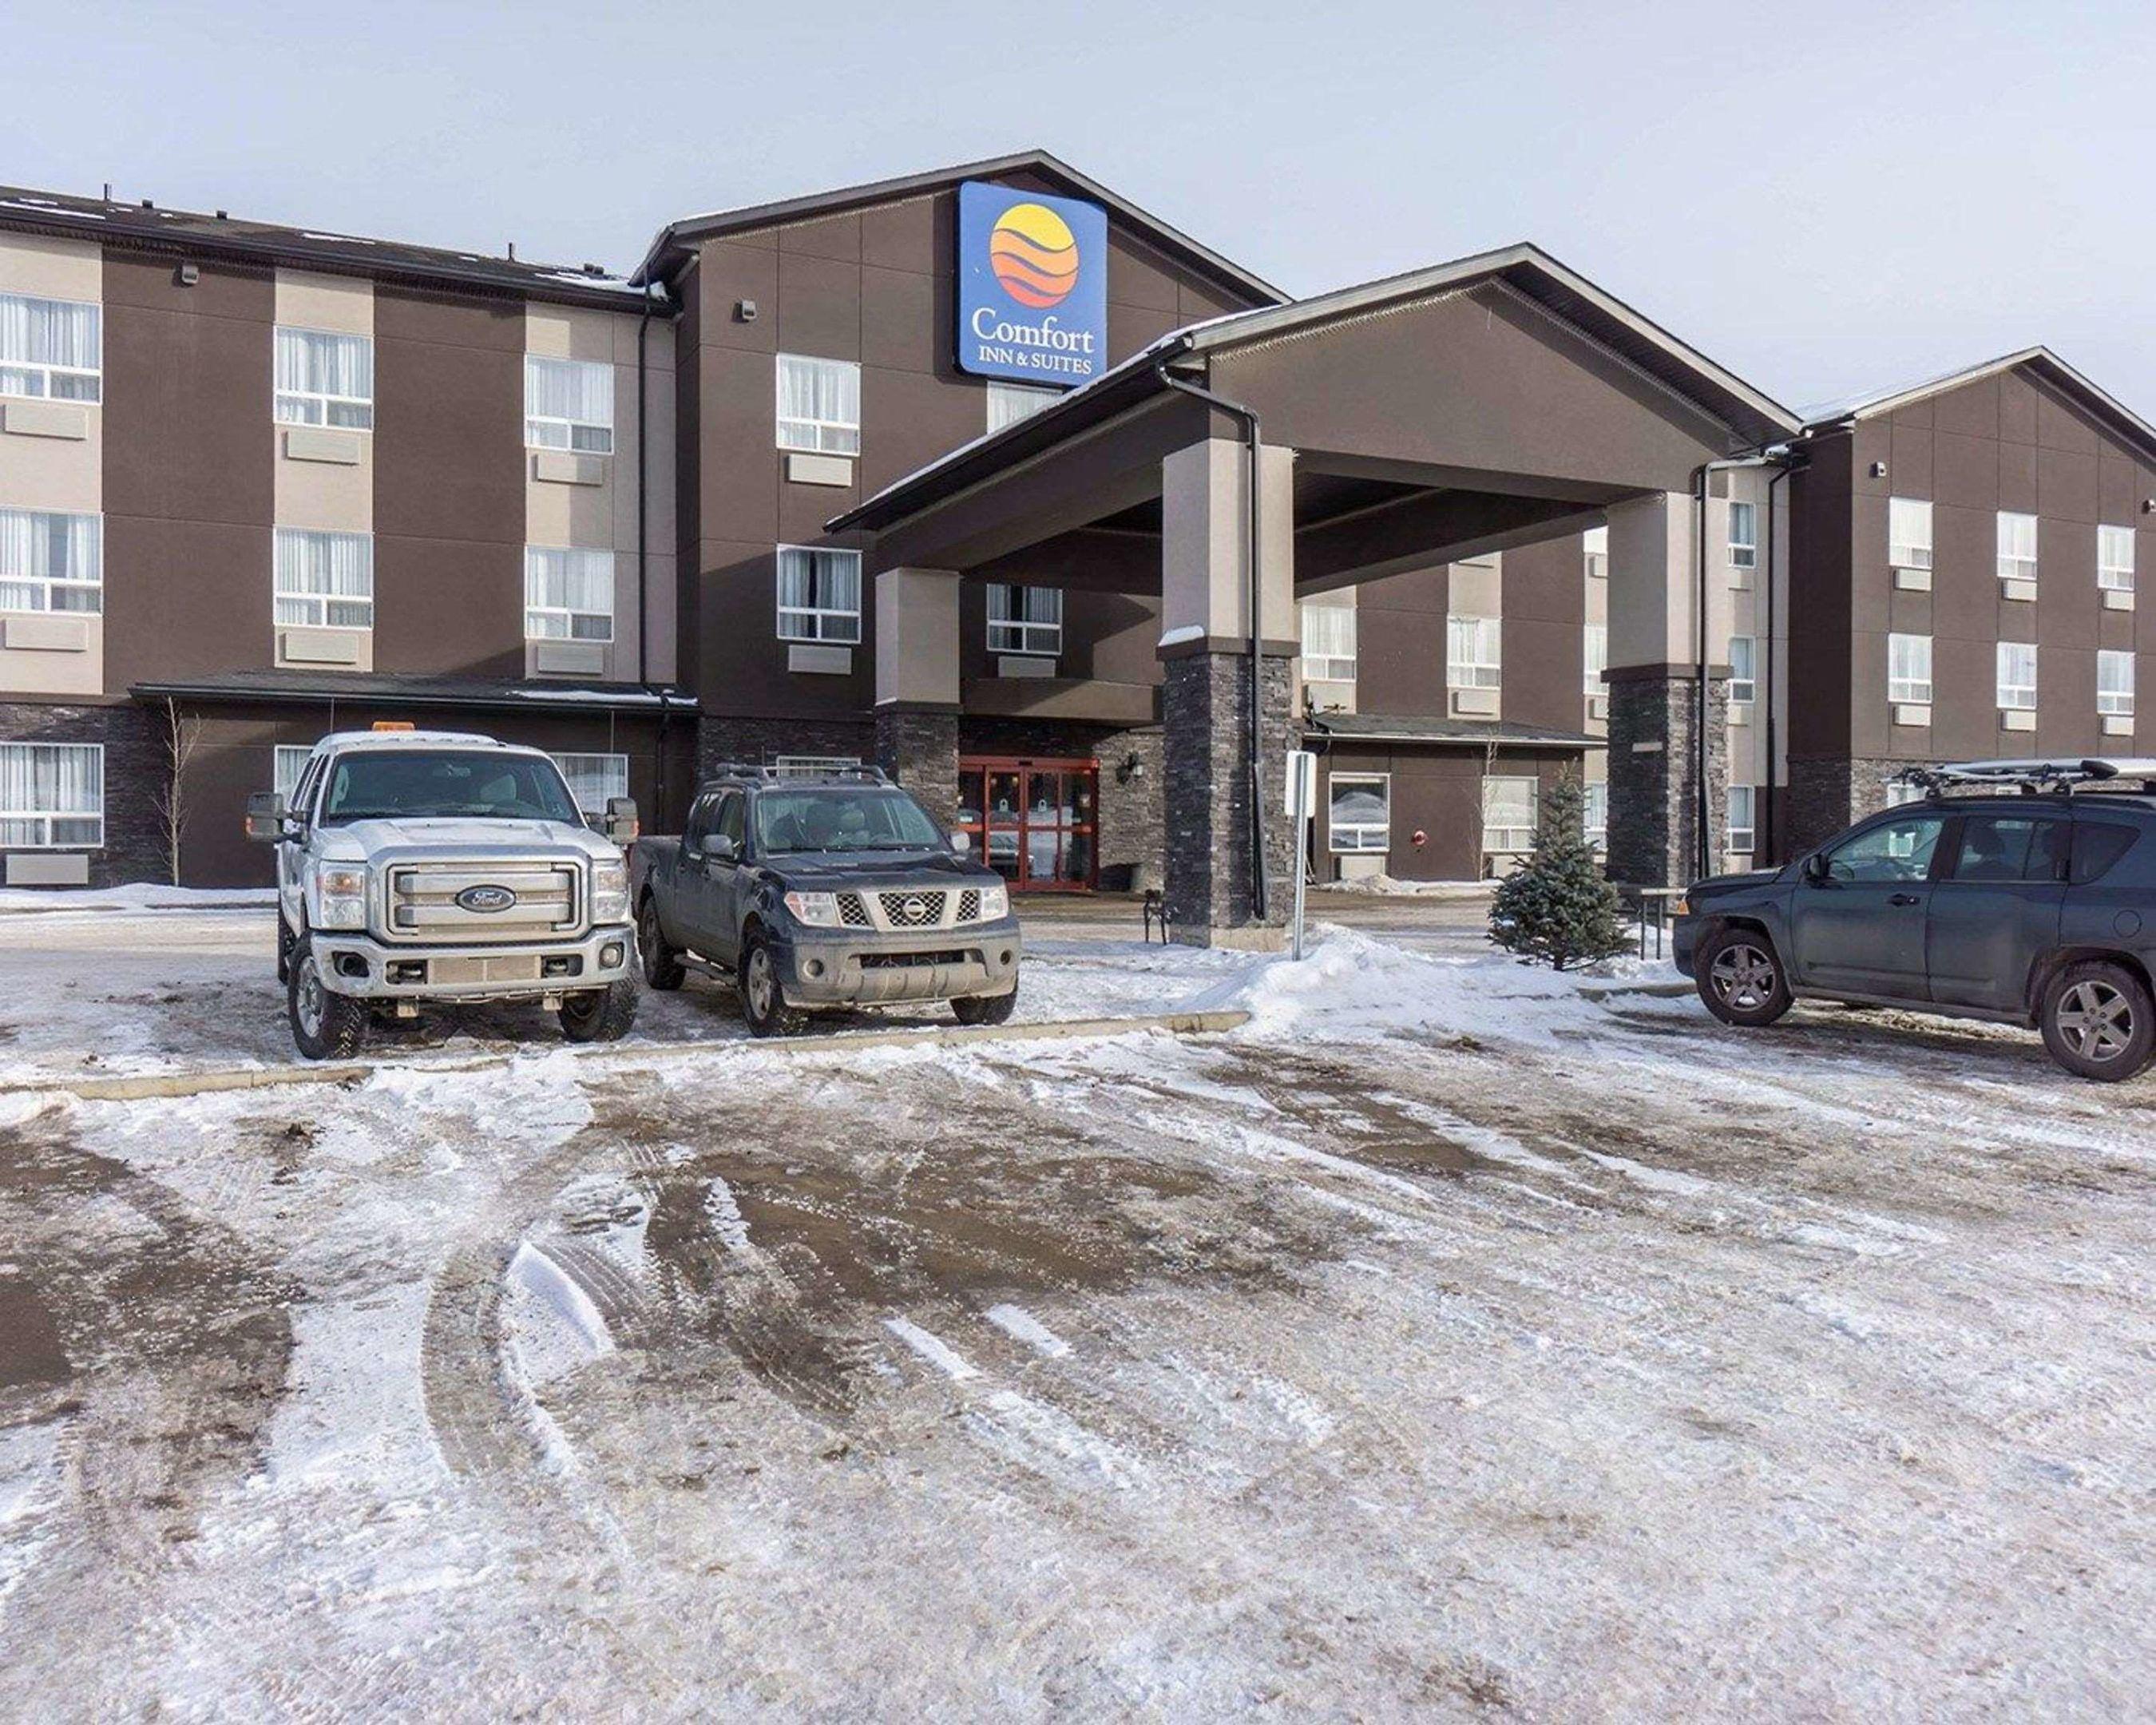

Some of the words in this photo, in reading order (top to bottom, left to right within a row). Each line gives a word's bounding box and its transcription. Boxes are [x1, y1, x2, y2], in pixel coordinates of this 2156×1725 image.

[972, 307, 1095, 354] Comfort
[979, 345, 1013, 363] INN
[1017, 351, 1028, 367] &
[1032, 352, 1092, 375] SUITES
[471, 890, 504, 906] Ford
